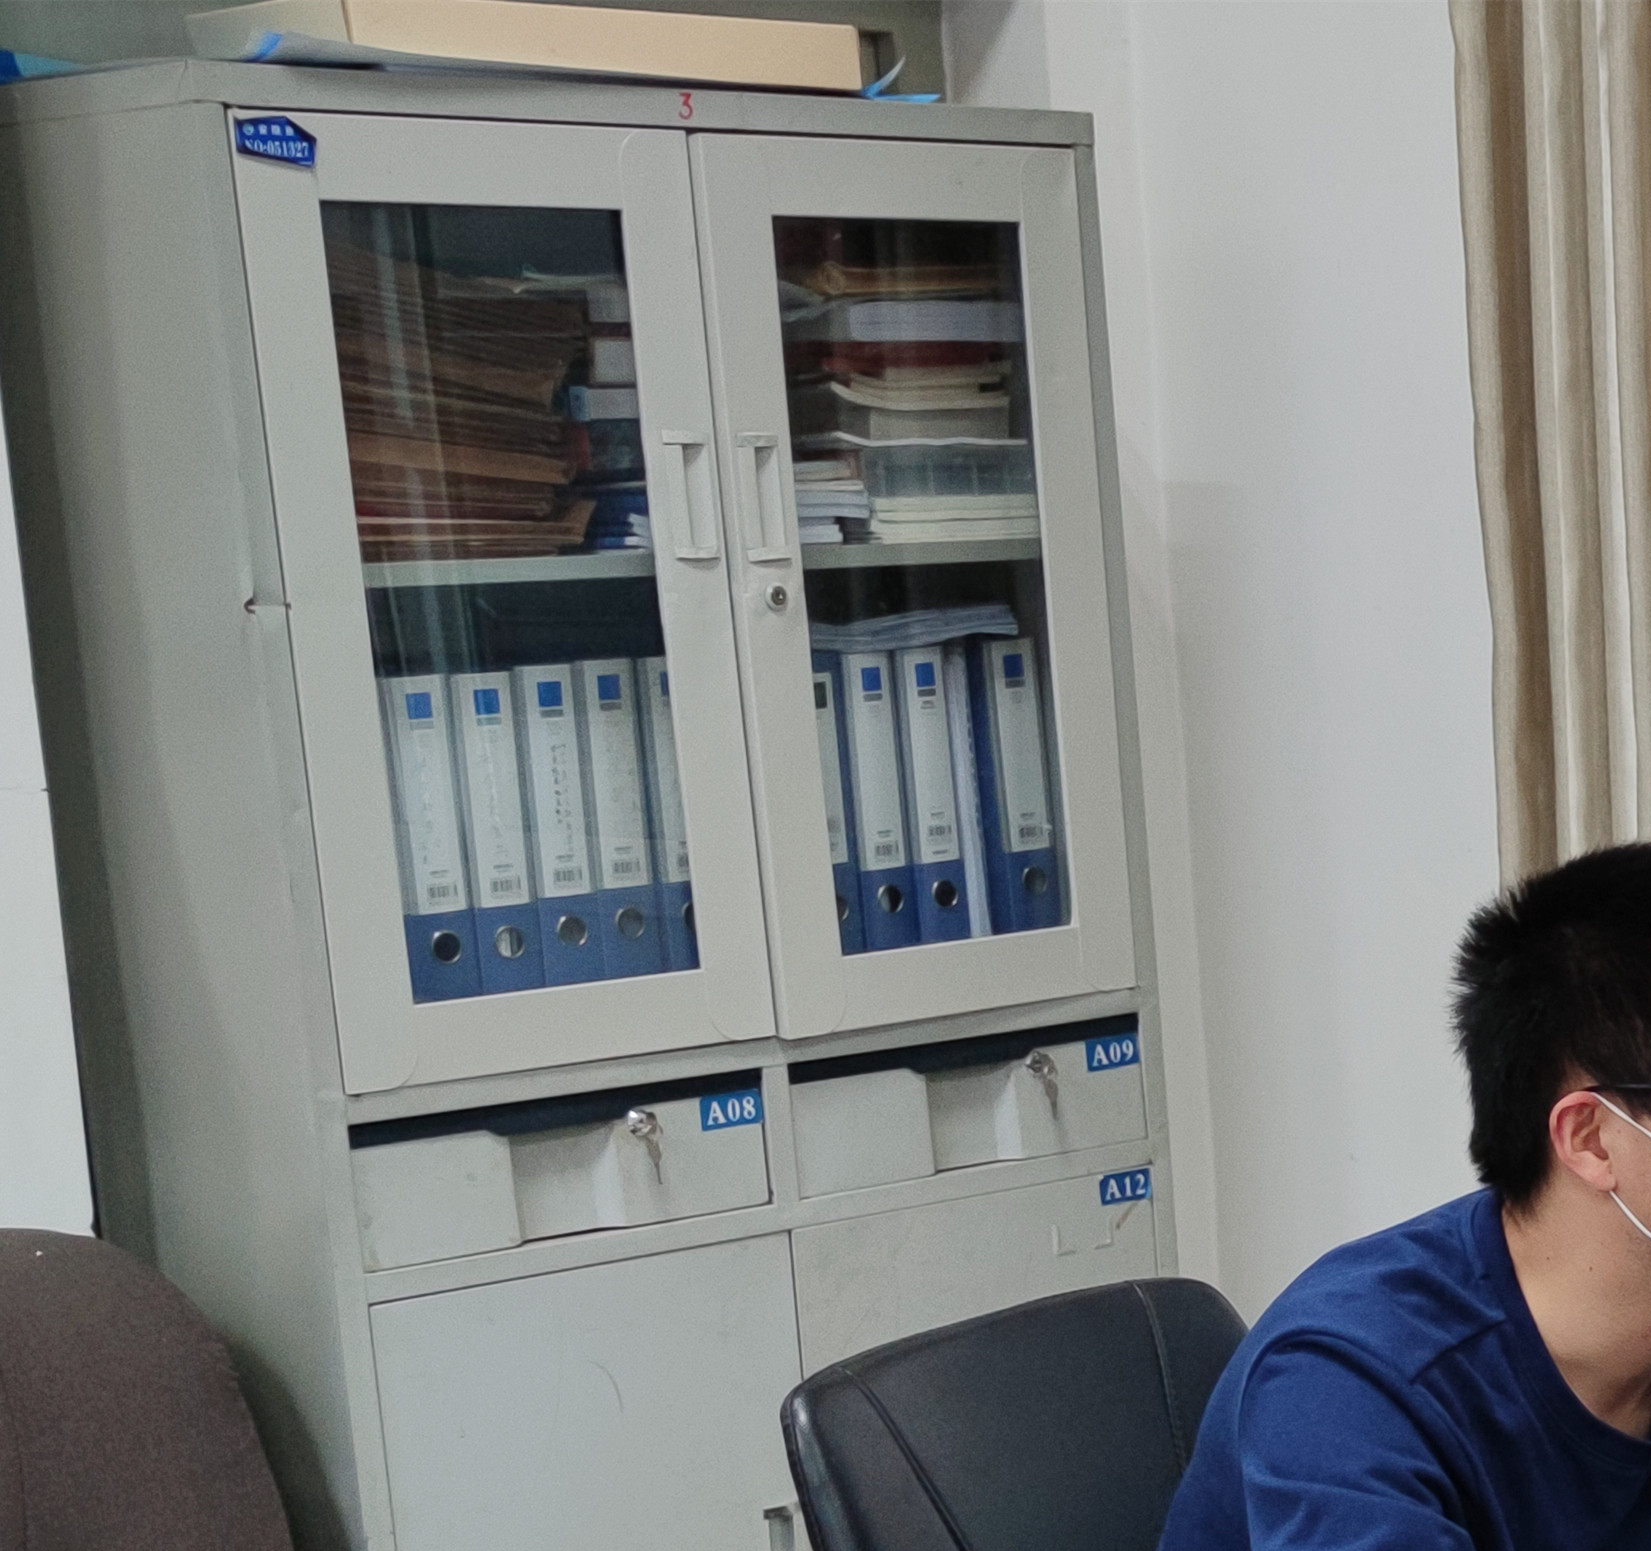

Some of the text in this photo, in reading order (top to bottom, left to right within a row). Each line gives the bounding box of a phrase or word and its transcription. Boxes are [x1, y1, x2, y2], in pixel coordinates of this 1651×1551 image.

[678, 92, 694, 120] 3
[1091, 1039, 1135, 1068] A09
[706, 1096, 757, 1126] A08
[1105, 1173, 1147, 1200] A12
